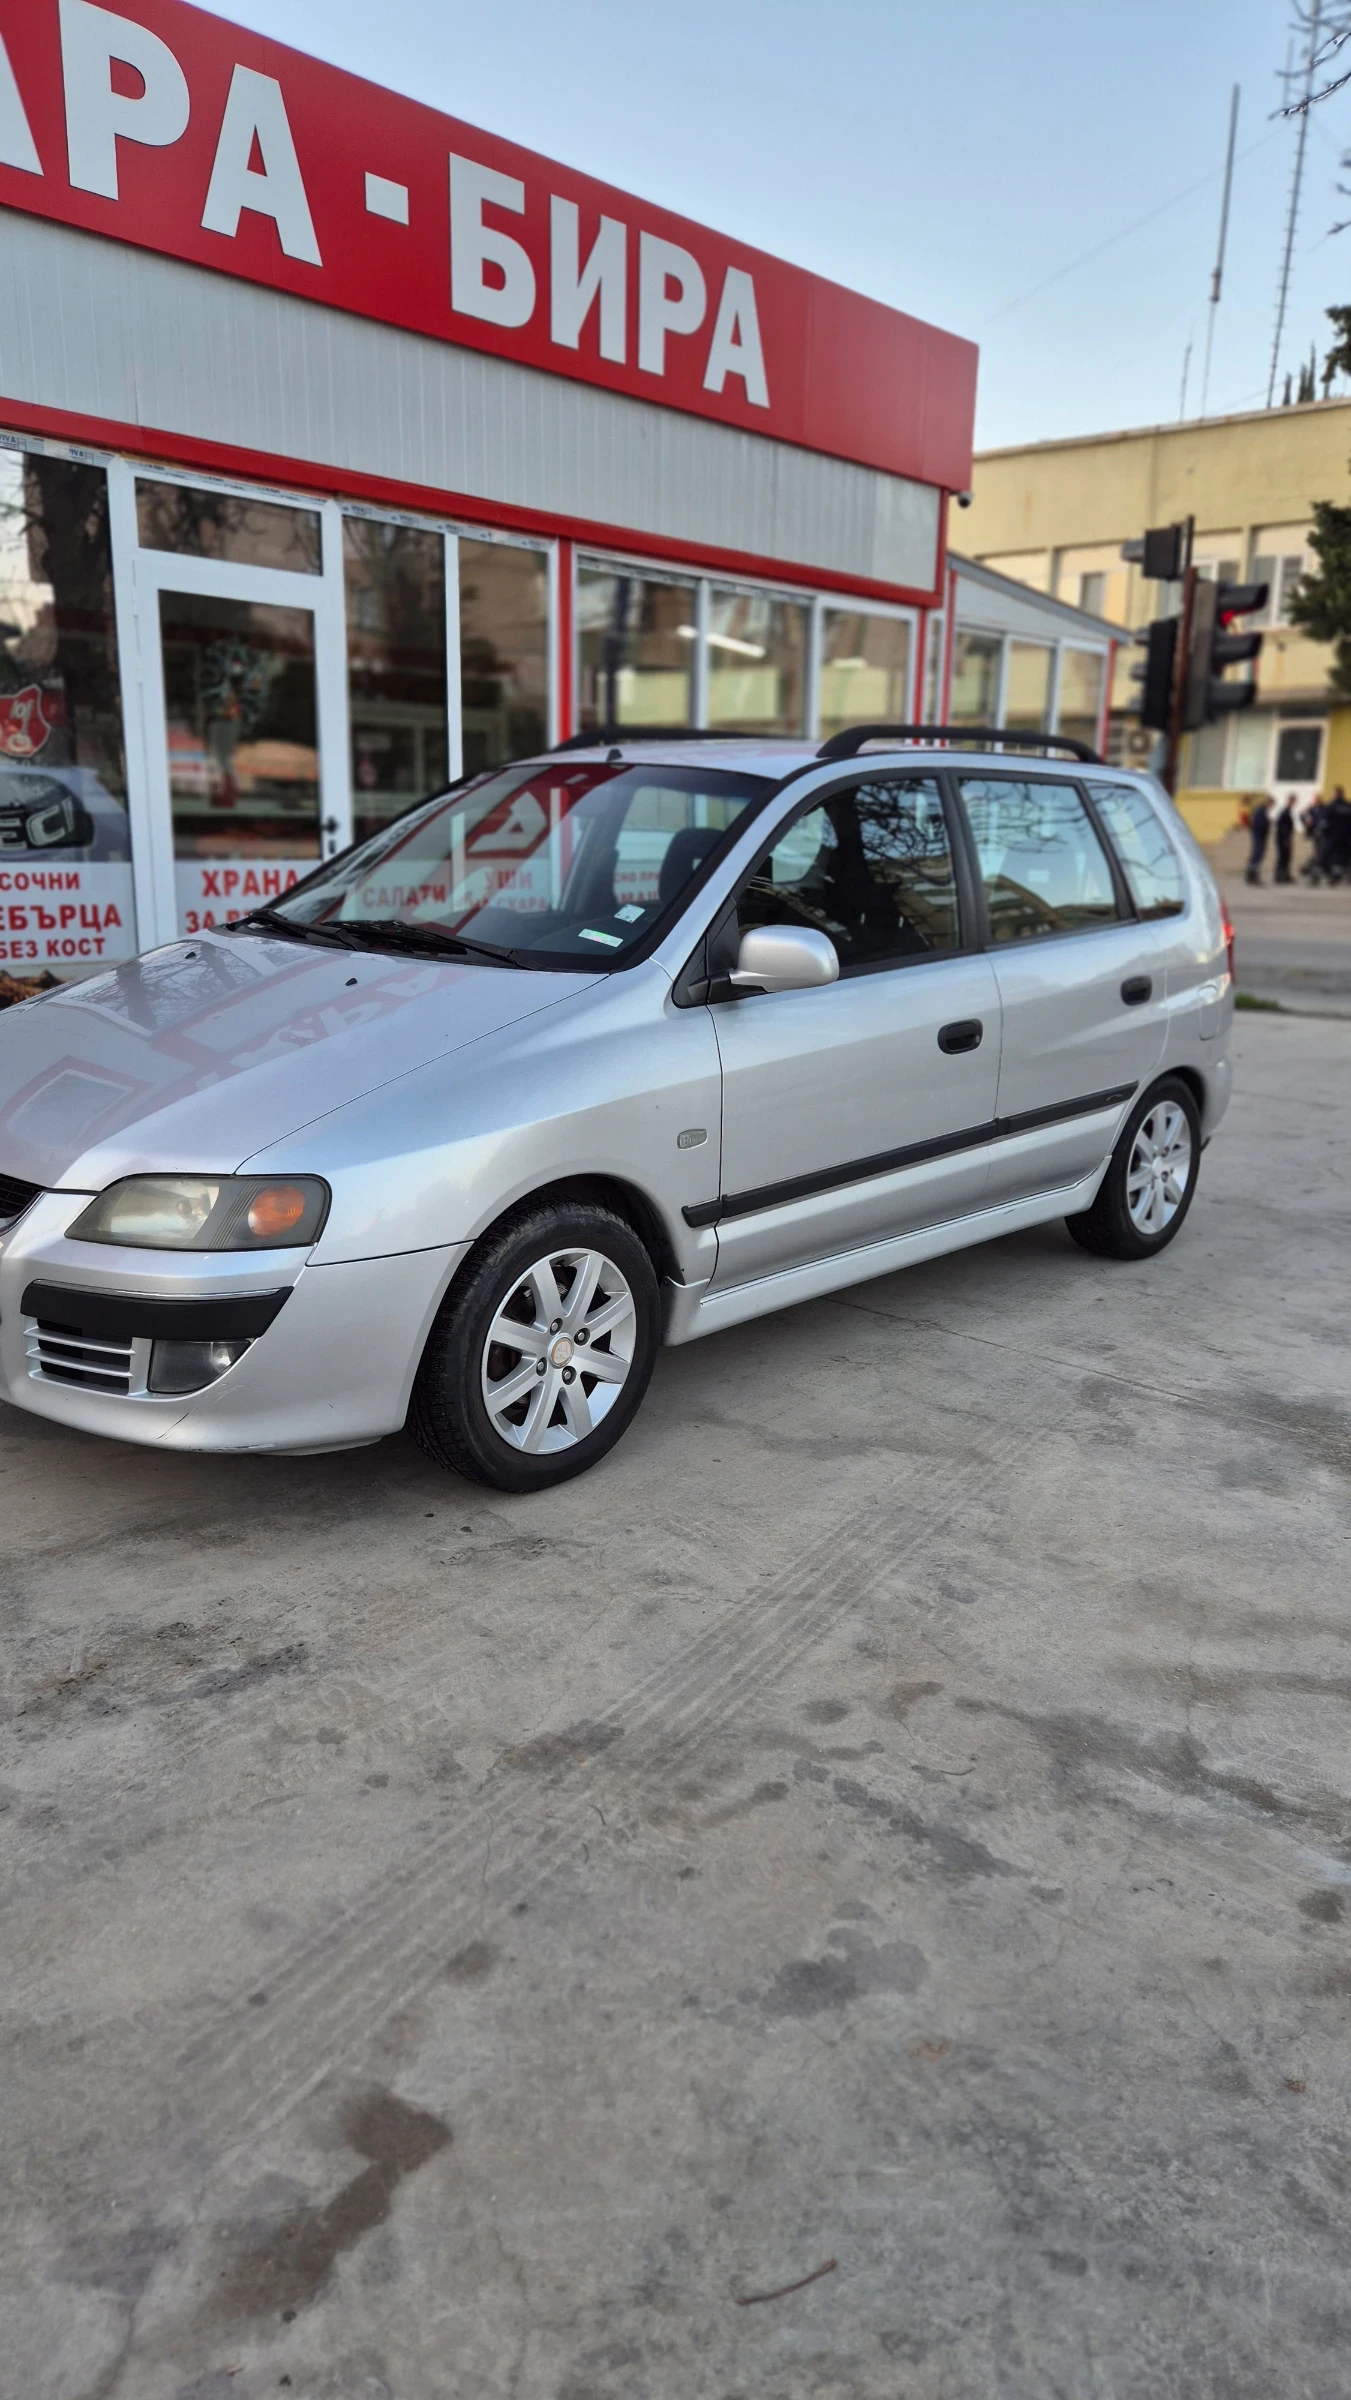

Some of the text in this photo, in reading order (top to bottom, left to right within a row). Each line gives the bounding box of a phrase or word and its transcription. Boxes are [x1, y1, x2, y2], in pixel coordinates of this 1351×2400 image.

[448, 151, 770, 410] БИРА
[0, 872, 80, 892] СОЧНИ
[202, 868, 299, 897] ХРАНА
[362, 884, 447, 909] САЛАТИ
[185, 910, 216, 934] ЗА
[46, 937, 106, 957] КОСТ
